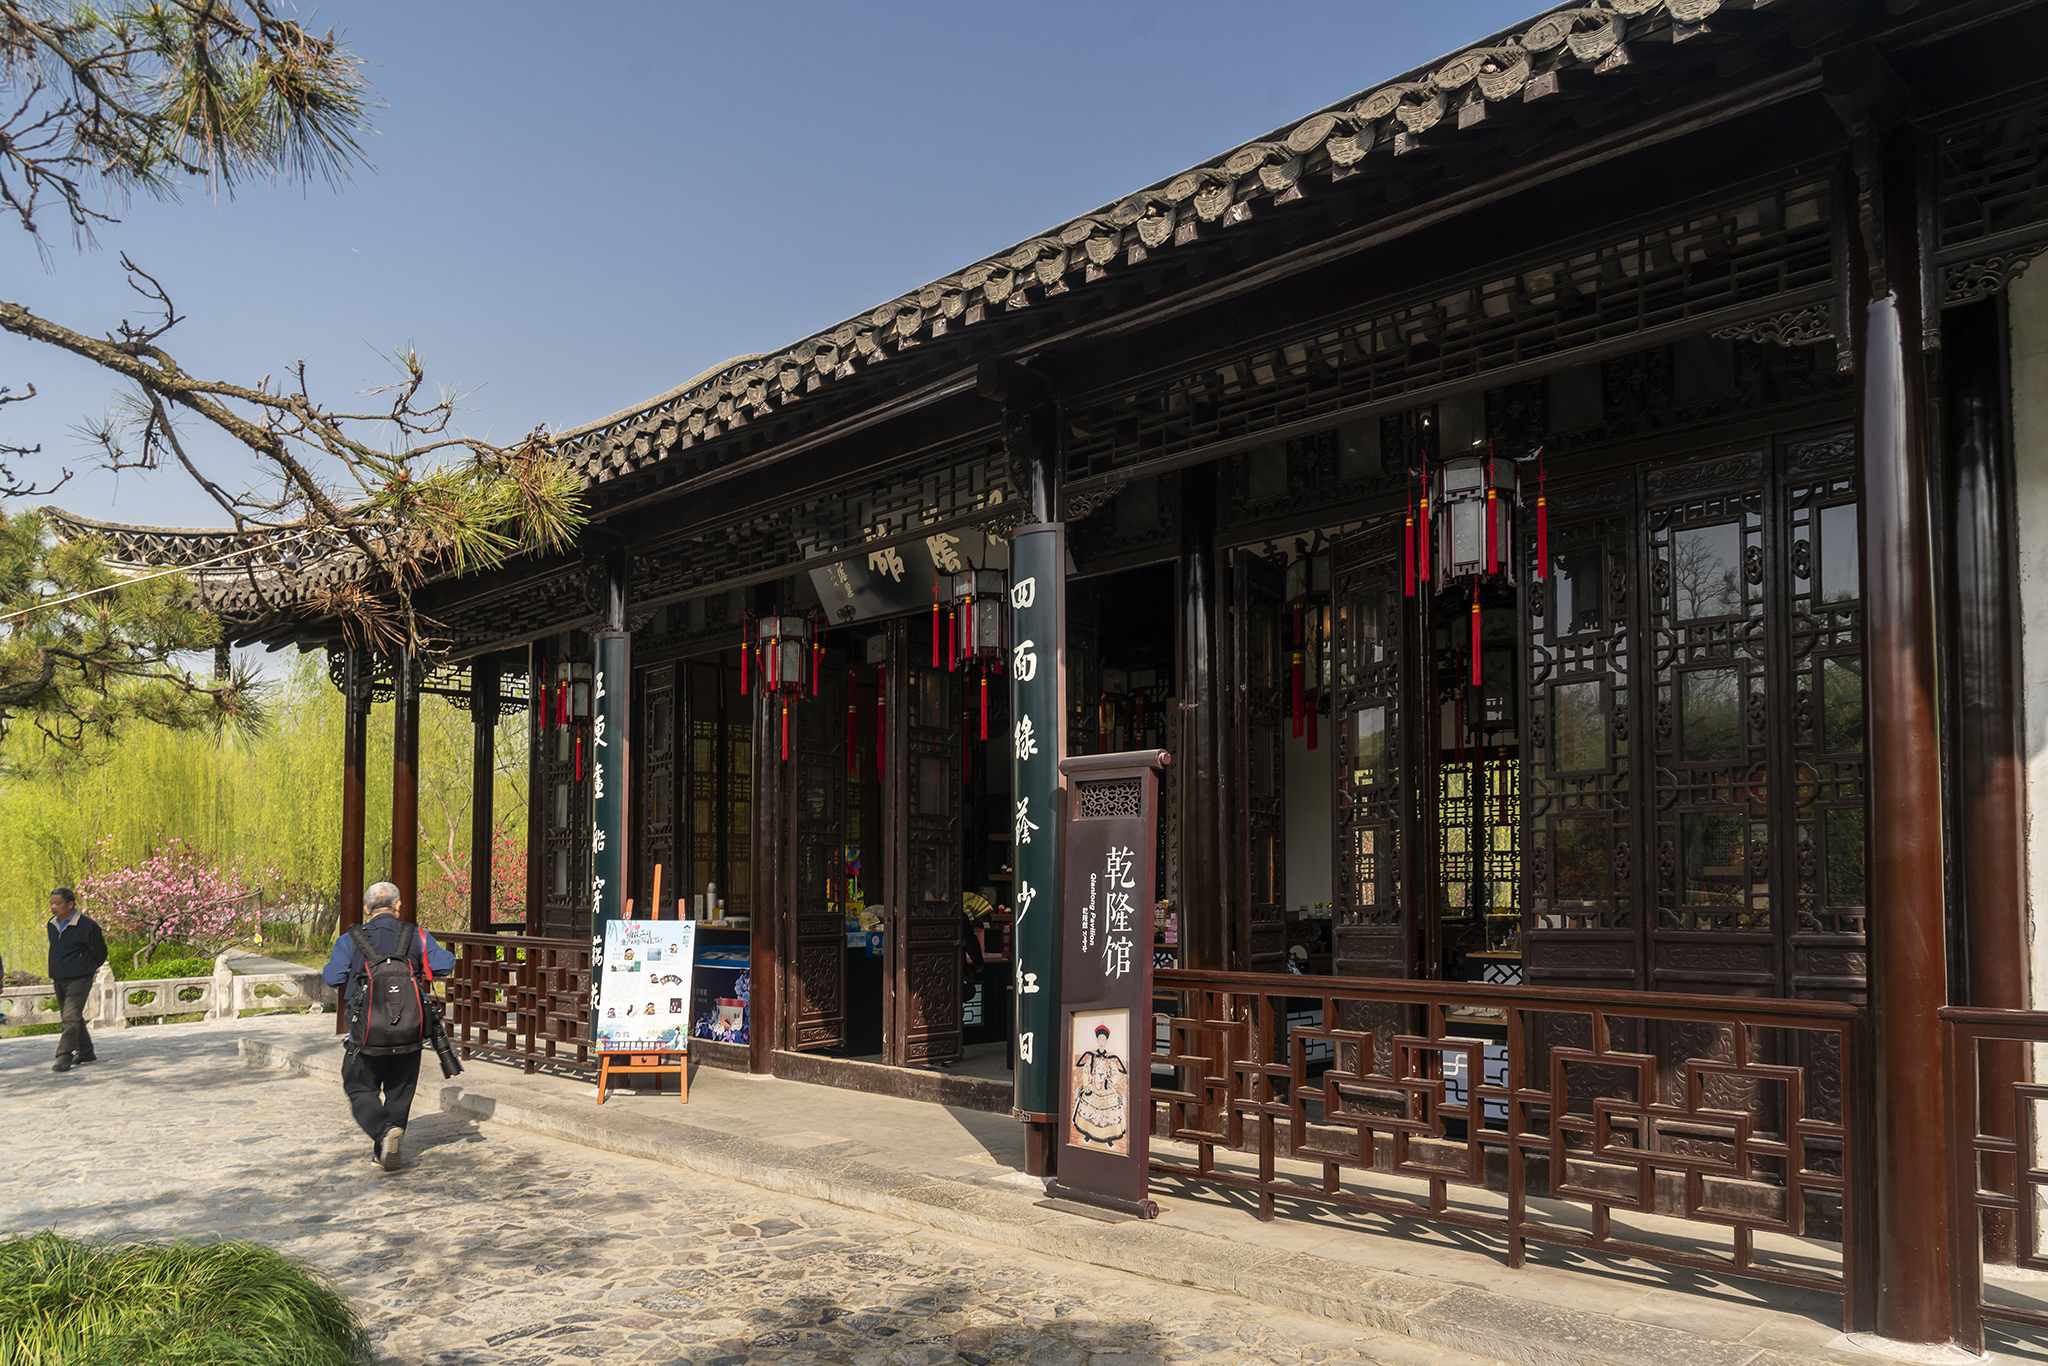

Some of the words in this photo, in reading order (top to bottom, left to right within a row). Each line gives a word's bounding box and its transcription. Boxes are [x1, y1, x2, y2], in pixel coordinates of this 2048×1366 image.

[1088, 872, 1098, 911] Qianlong
[1088, 911, 1097, 946] Pavilion
[1101, 845, 1136, 980] 乾隆馆
